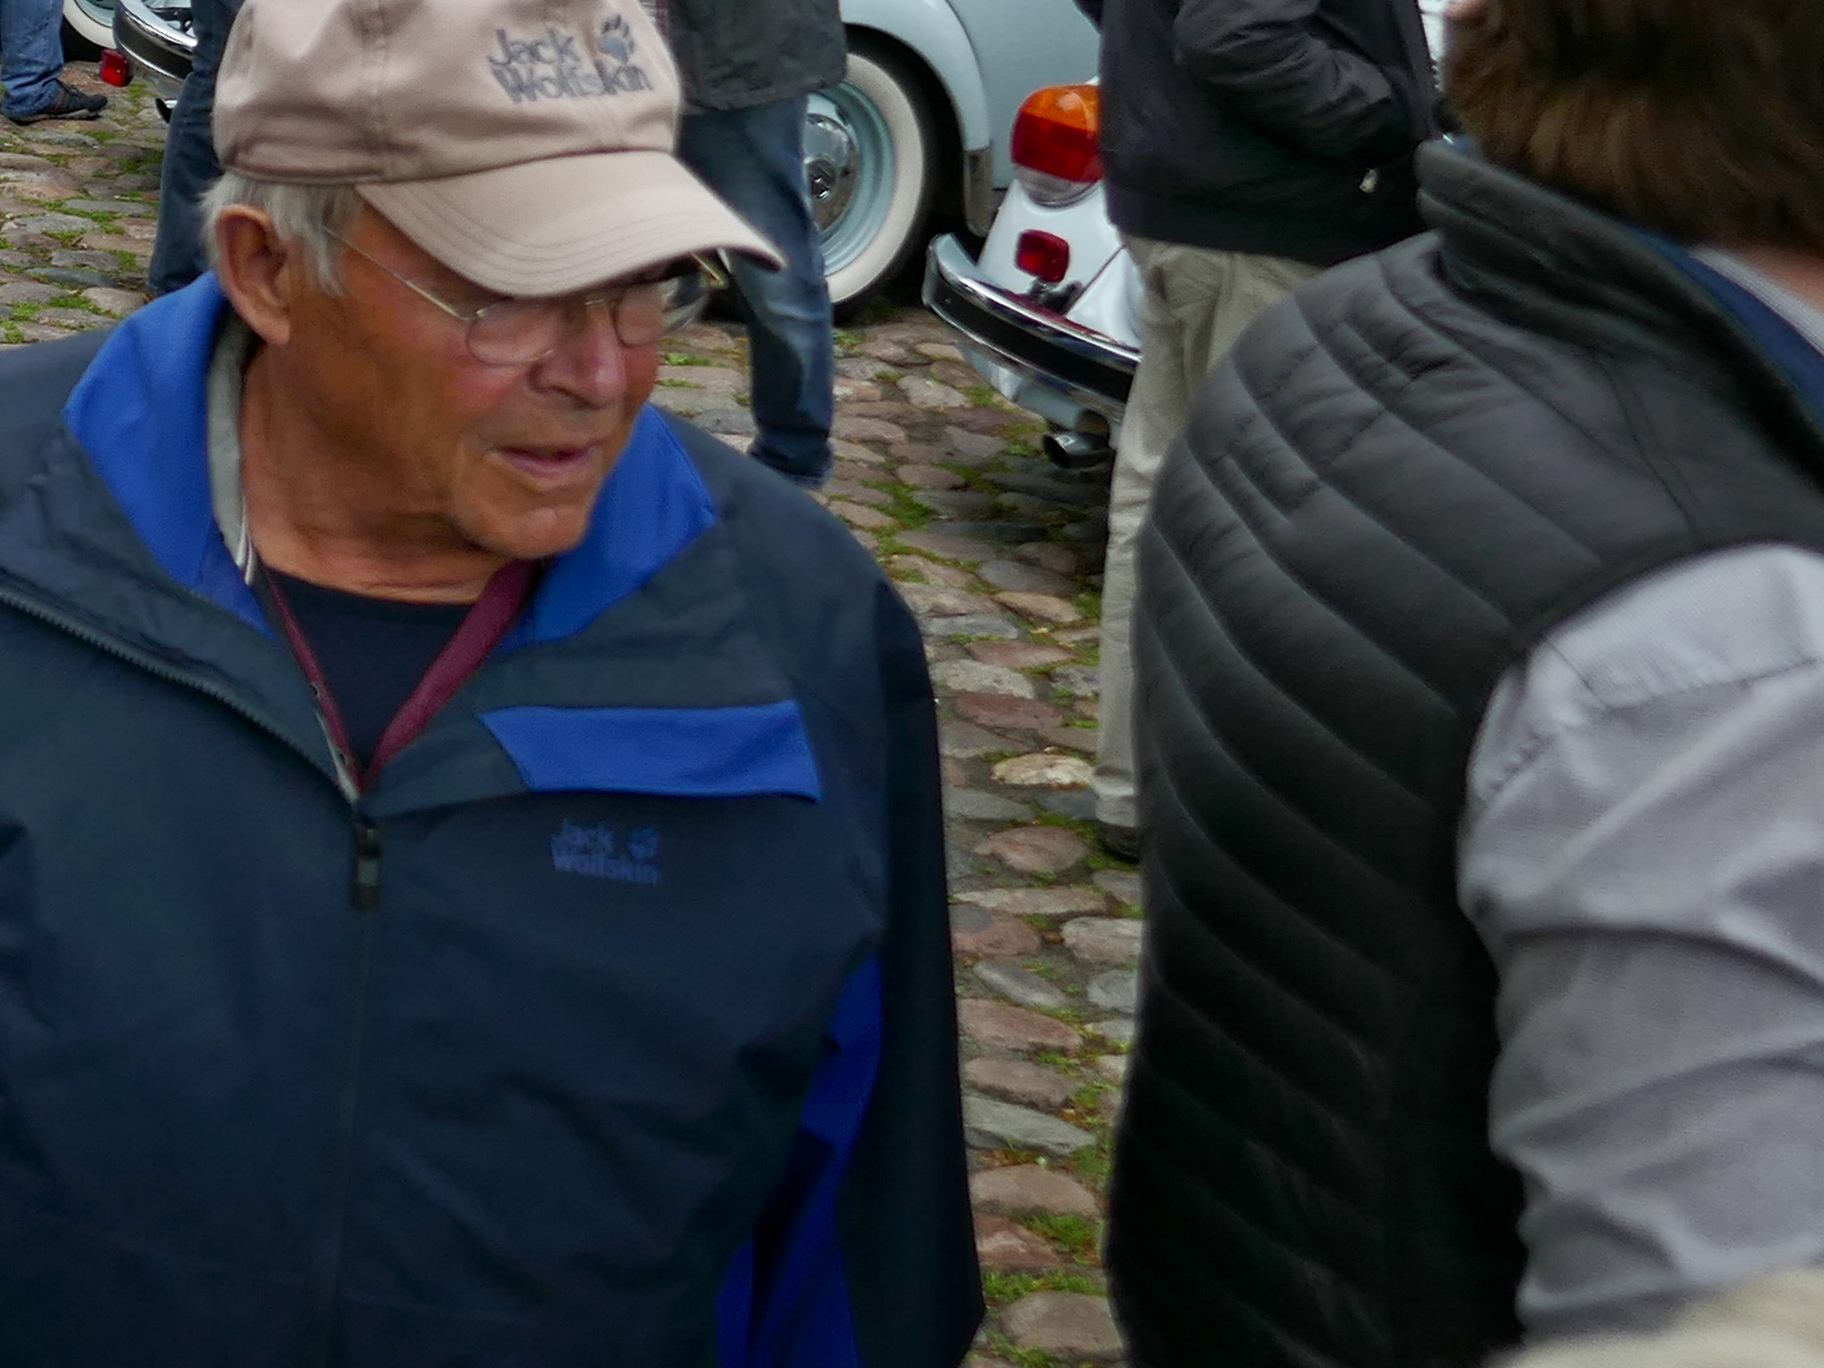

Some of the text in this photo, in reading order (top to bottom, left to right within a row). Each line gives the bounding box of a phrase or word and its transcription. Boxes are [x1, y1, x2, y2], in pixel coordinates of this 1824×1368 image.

[486, 28, 581, 66] Jack
[491, 59, 654, 103] Wolfskin
[551, 818, 616, 852] Jack
[552, 851, 658, 884] Wolfskin
